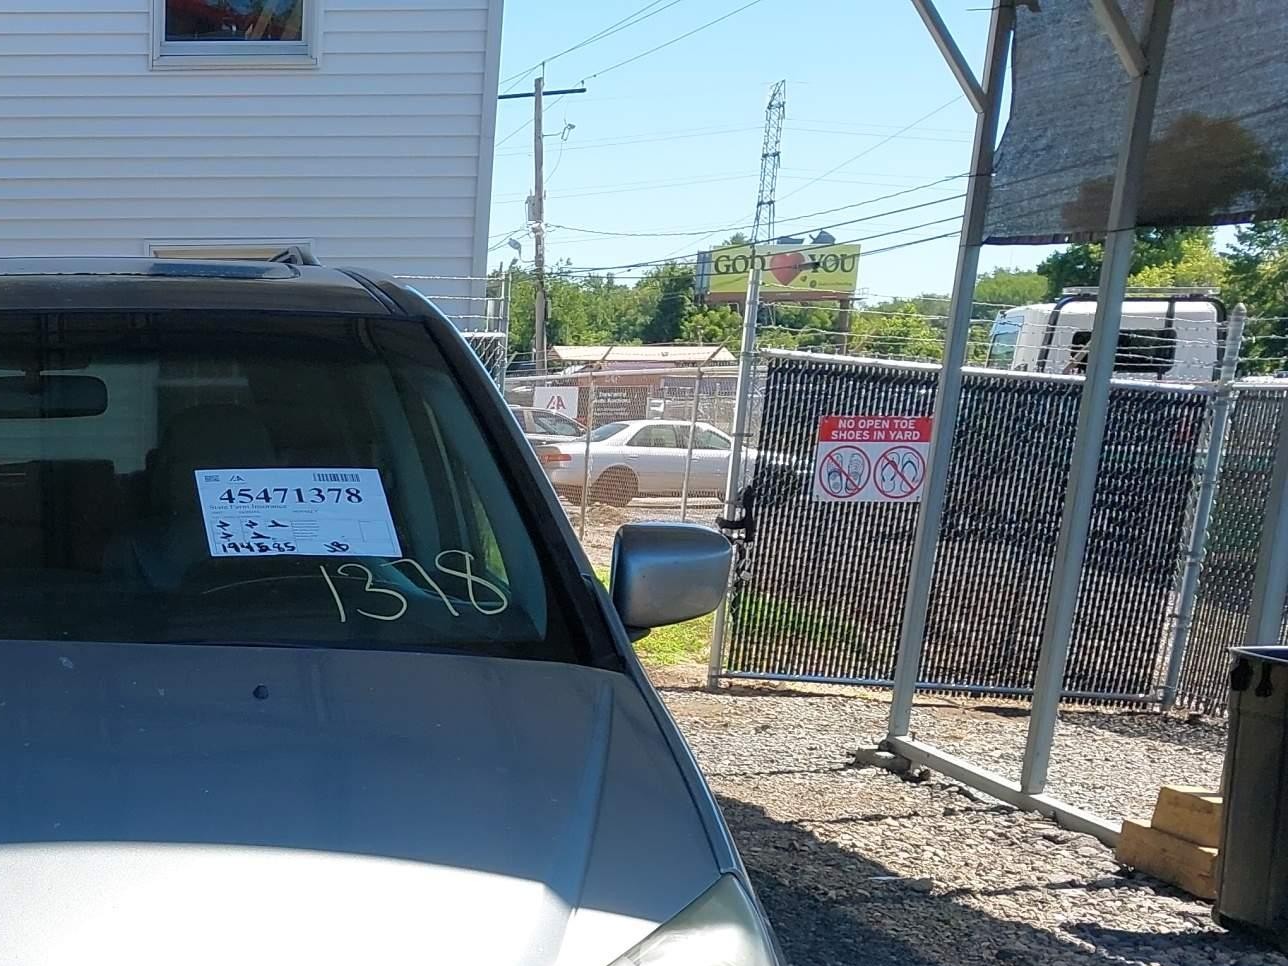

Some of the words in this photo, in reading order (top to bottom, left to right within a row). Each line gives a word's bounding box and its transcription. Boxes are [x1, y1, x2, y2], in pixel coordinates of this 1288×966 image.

[714, 254, 766, 275] GOD
[808, 253, 857, 273] YOU
[838, 419, 855, 429] NO
[858, 419, 890, 429] OPEN
[893, 419, 916, 429] TOE
[831, 430, 870, 440] SHOES
[873, 430, 886, 440] IN
[889, 430, 921, 441] YARD
[219, 487, 364, 504] 45471378
[319, 549, 508, 623] 1378
